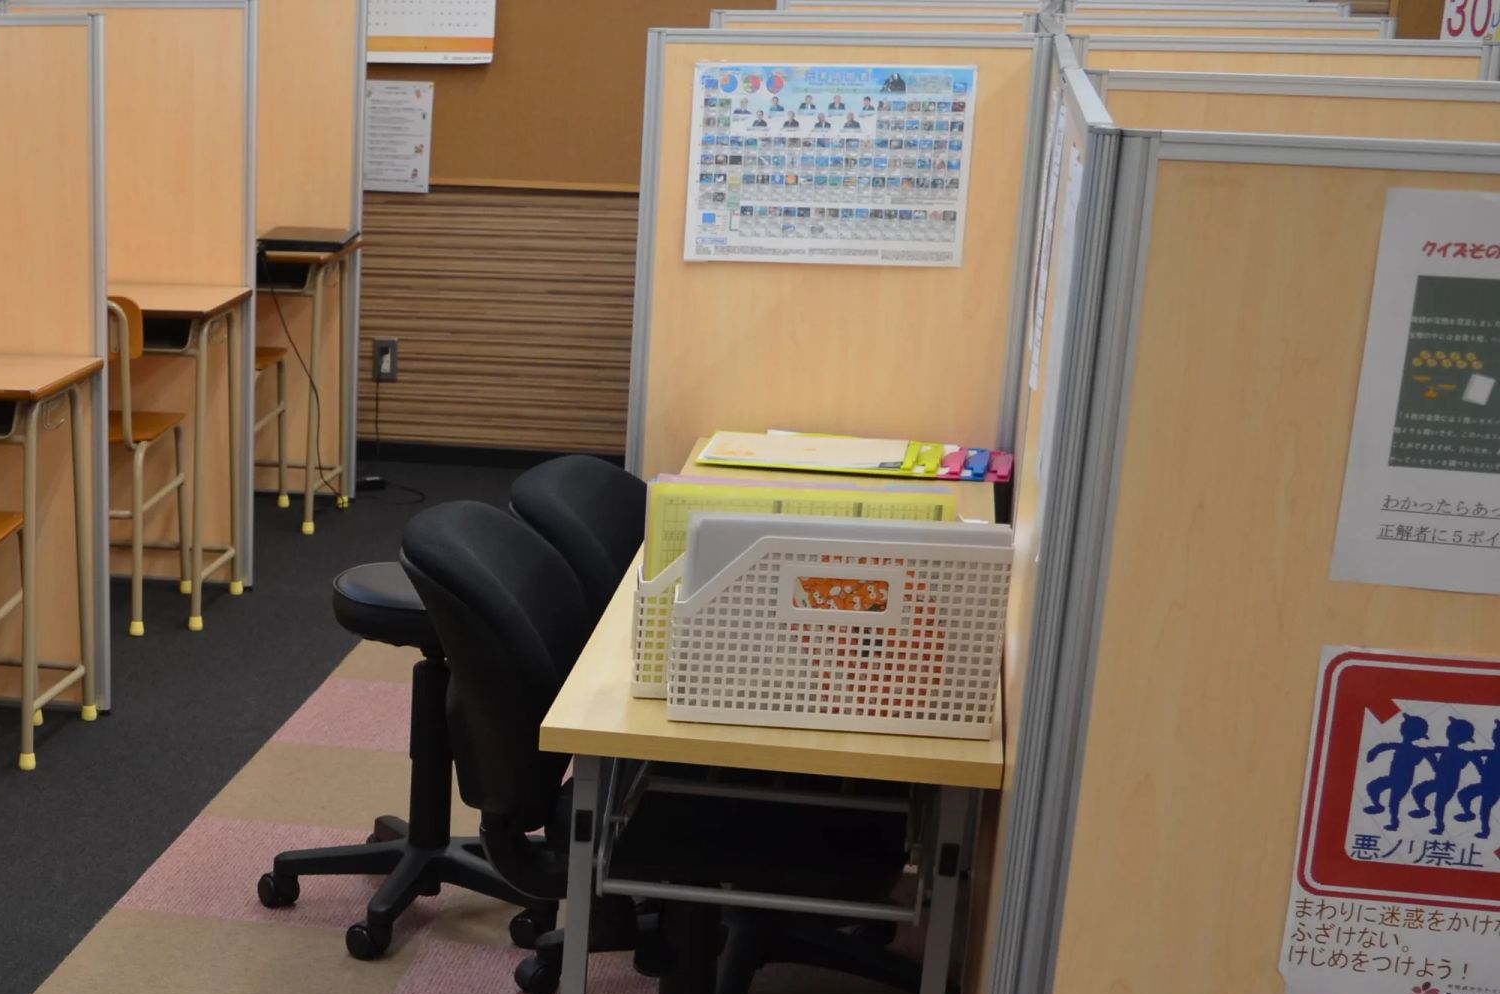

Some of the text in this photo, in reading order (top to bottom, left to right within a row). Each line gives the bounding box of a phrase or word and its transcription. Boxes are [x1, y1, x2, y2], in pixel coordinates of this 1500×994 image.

[1350, 833, 1484, 869] 悪ノリ禁止
[1290, 922, 1411, 953] ふざけない。
